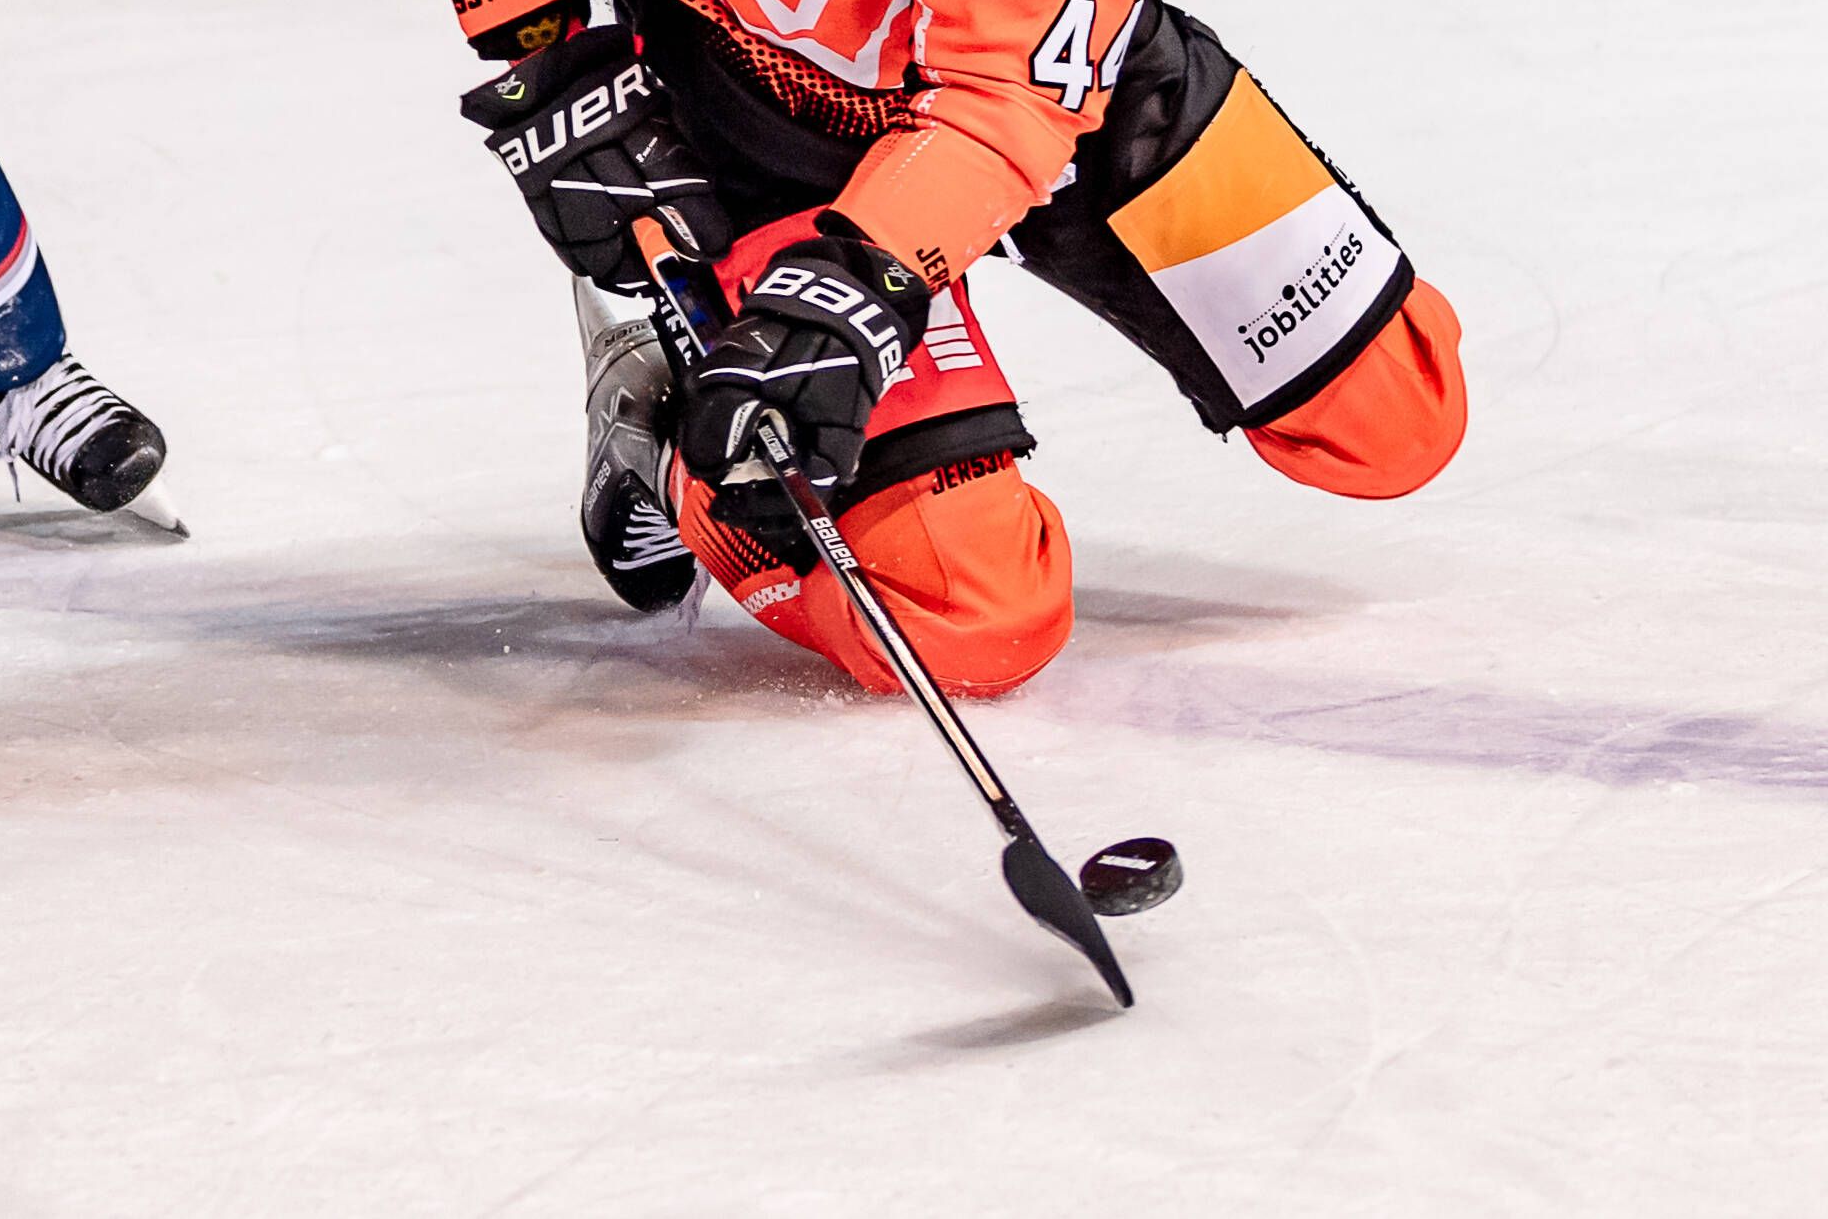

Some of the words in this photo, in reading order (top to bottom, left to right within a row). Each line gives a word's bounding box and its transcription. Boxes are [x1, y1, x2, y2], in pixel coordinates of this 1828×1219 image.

[498, 63, 651, 176] AUER
[753, 266, 905, 381] BAUE
[1238, 231, 1363, 364] jobilities
[810, 516, 860, 571] BAUER
